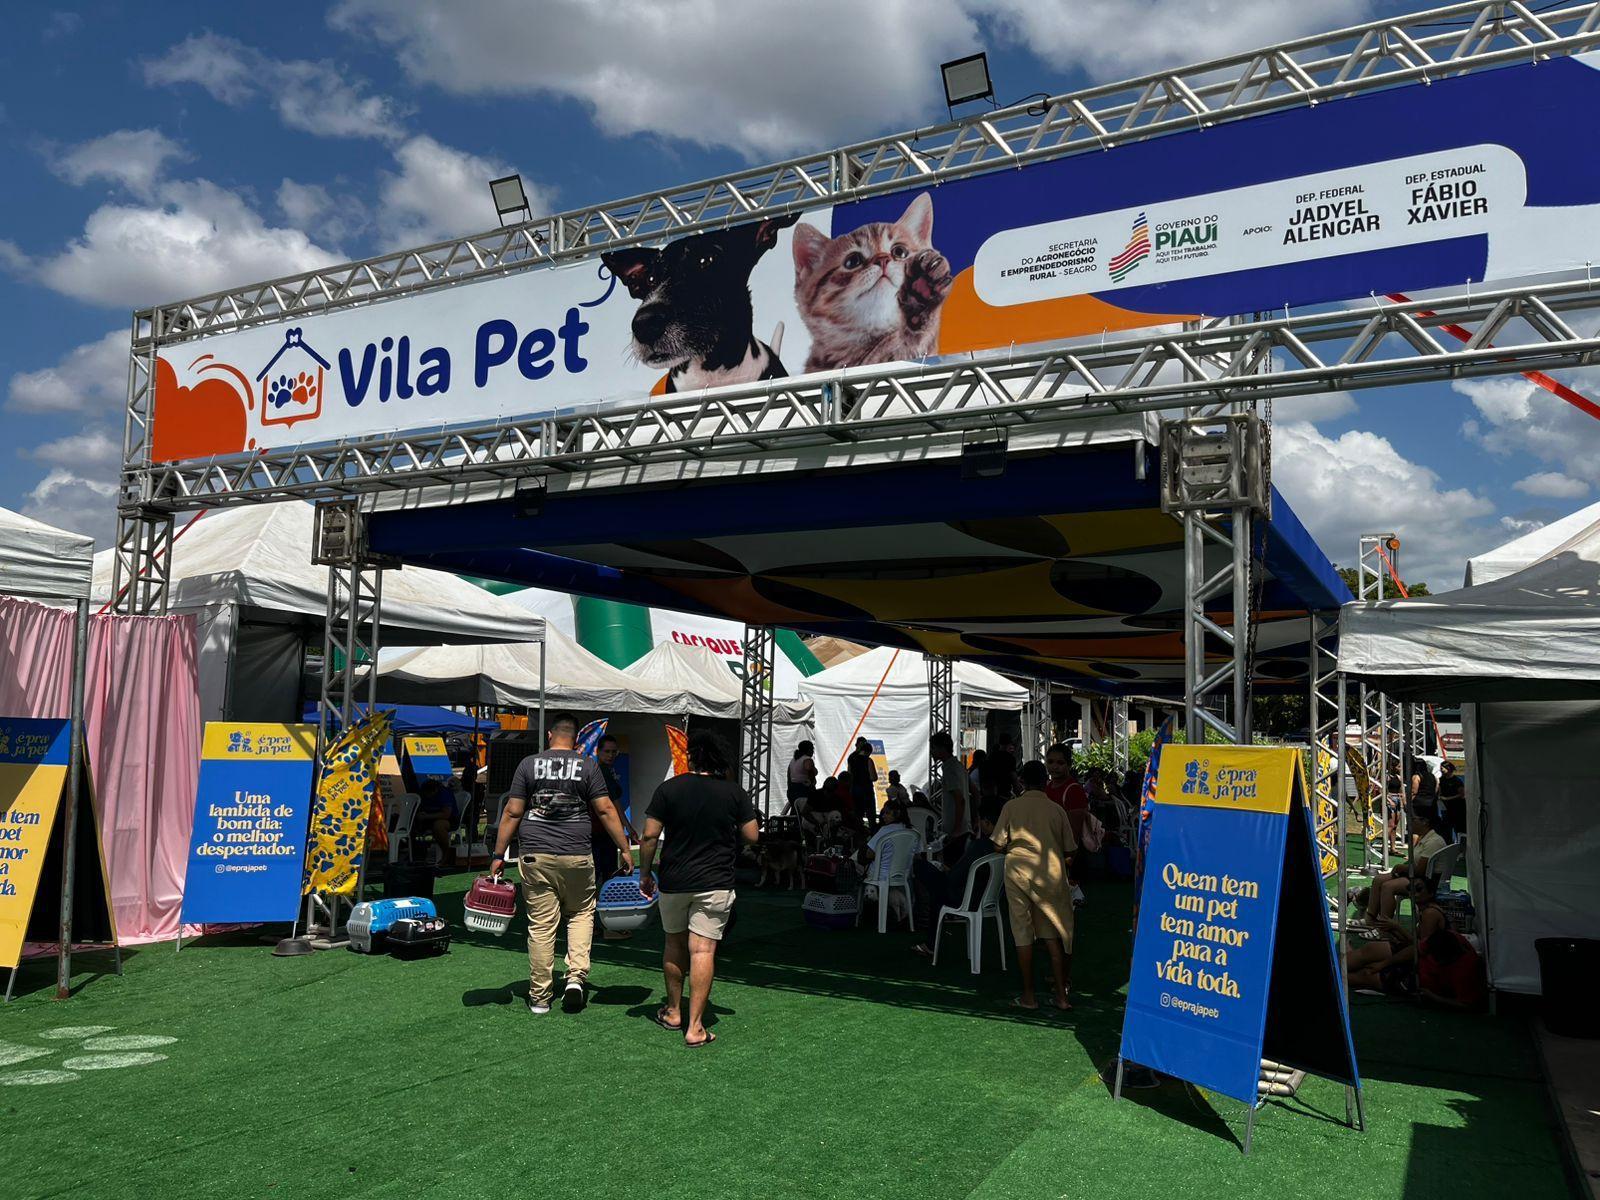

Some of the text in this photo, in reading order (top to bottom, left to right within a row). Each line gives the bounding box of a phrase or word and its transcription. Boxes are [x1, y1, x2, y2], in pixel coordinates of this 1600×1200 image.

[1405, 164, 1486, 185] DEP. ESTADUAL
[1295, 184, 1364, 204] DEP. FEDERAL
[1411, 180, 1477, 206] FÁBIO
[1289, 199, 1369, 226] JADYEL
[1407, 197, 1488, 225] XAVIER
[1155, 214, 1218, 231] GOVERNO DO
[1243, 225, 1272, 236] APOIO:
[1283, 214, 1381, 245] ALENCAR
[1049, 238, 1098, 252] SECRETARIA
[1007, 256, 1095, 276] EMPREENDEDORISMO
[1022, 247, 1096, 265] DO AGRONEGÓCIO
[1029, 271, 1057, 281] RURAL
[1063, 264, 1098, 275] SEAGRO
[338, 307, 590, 407] Vila Pet
[533, 757, 584, 781] BLUE
[1216, 765, 1257, 785] é pra
[234, 791, 271, 804] Uma
[1230, 783, 1257, 801] pet
[10, 809, 40, 824] tem
[209, 804, 293, 817] lambida de
[217, 817, 283, 830] bom dia:
[213, 830, 284, 843] o melhor
[196, 842, 296, 859] despertador.
[1162, 862, 1258, 899] Quem tem
[1174, 893, 1238, 922] um pet
[1160, 912, 1249, 947] tem amor
[1172, 939, 1228, 966] para a
[1197, 968, 1241, 999] toda.
[1171, 996, 1219, 1018] @eprajapet
